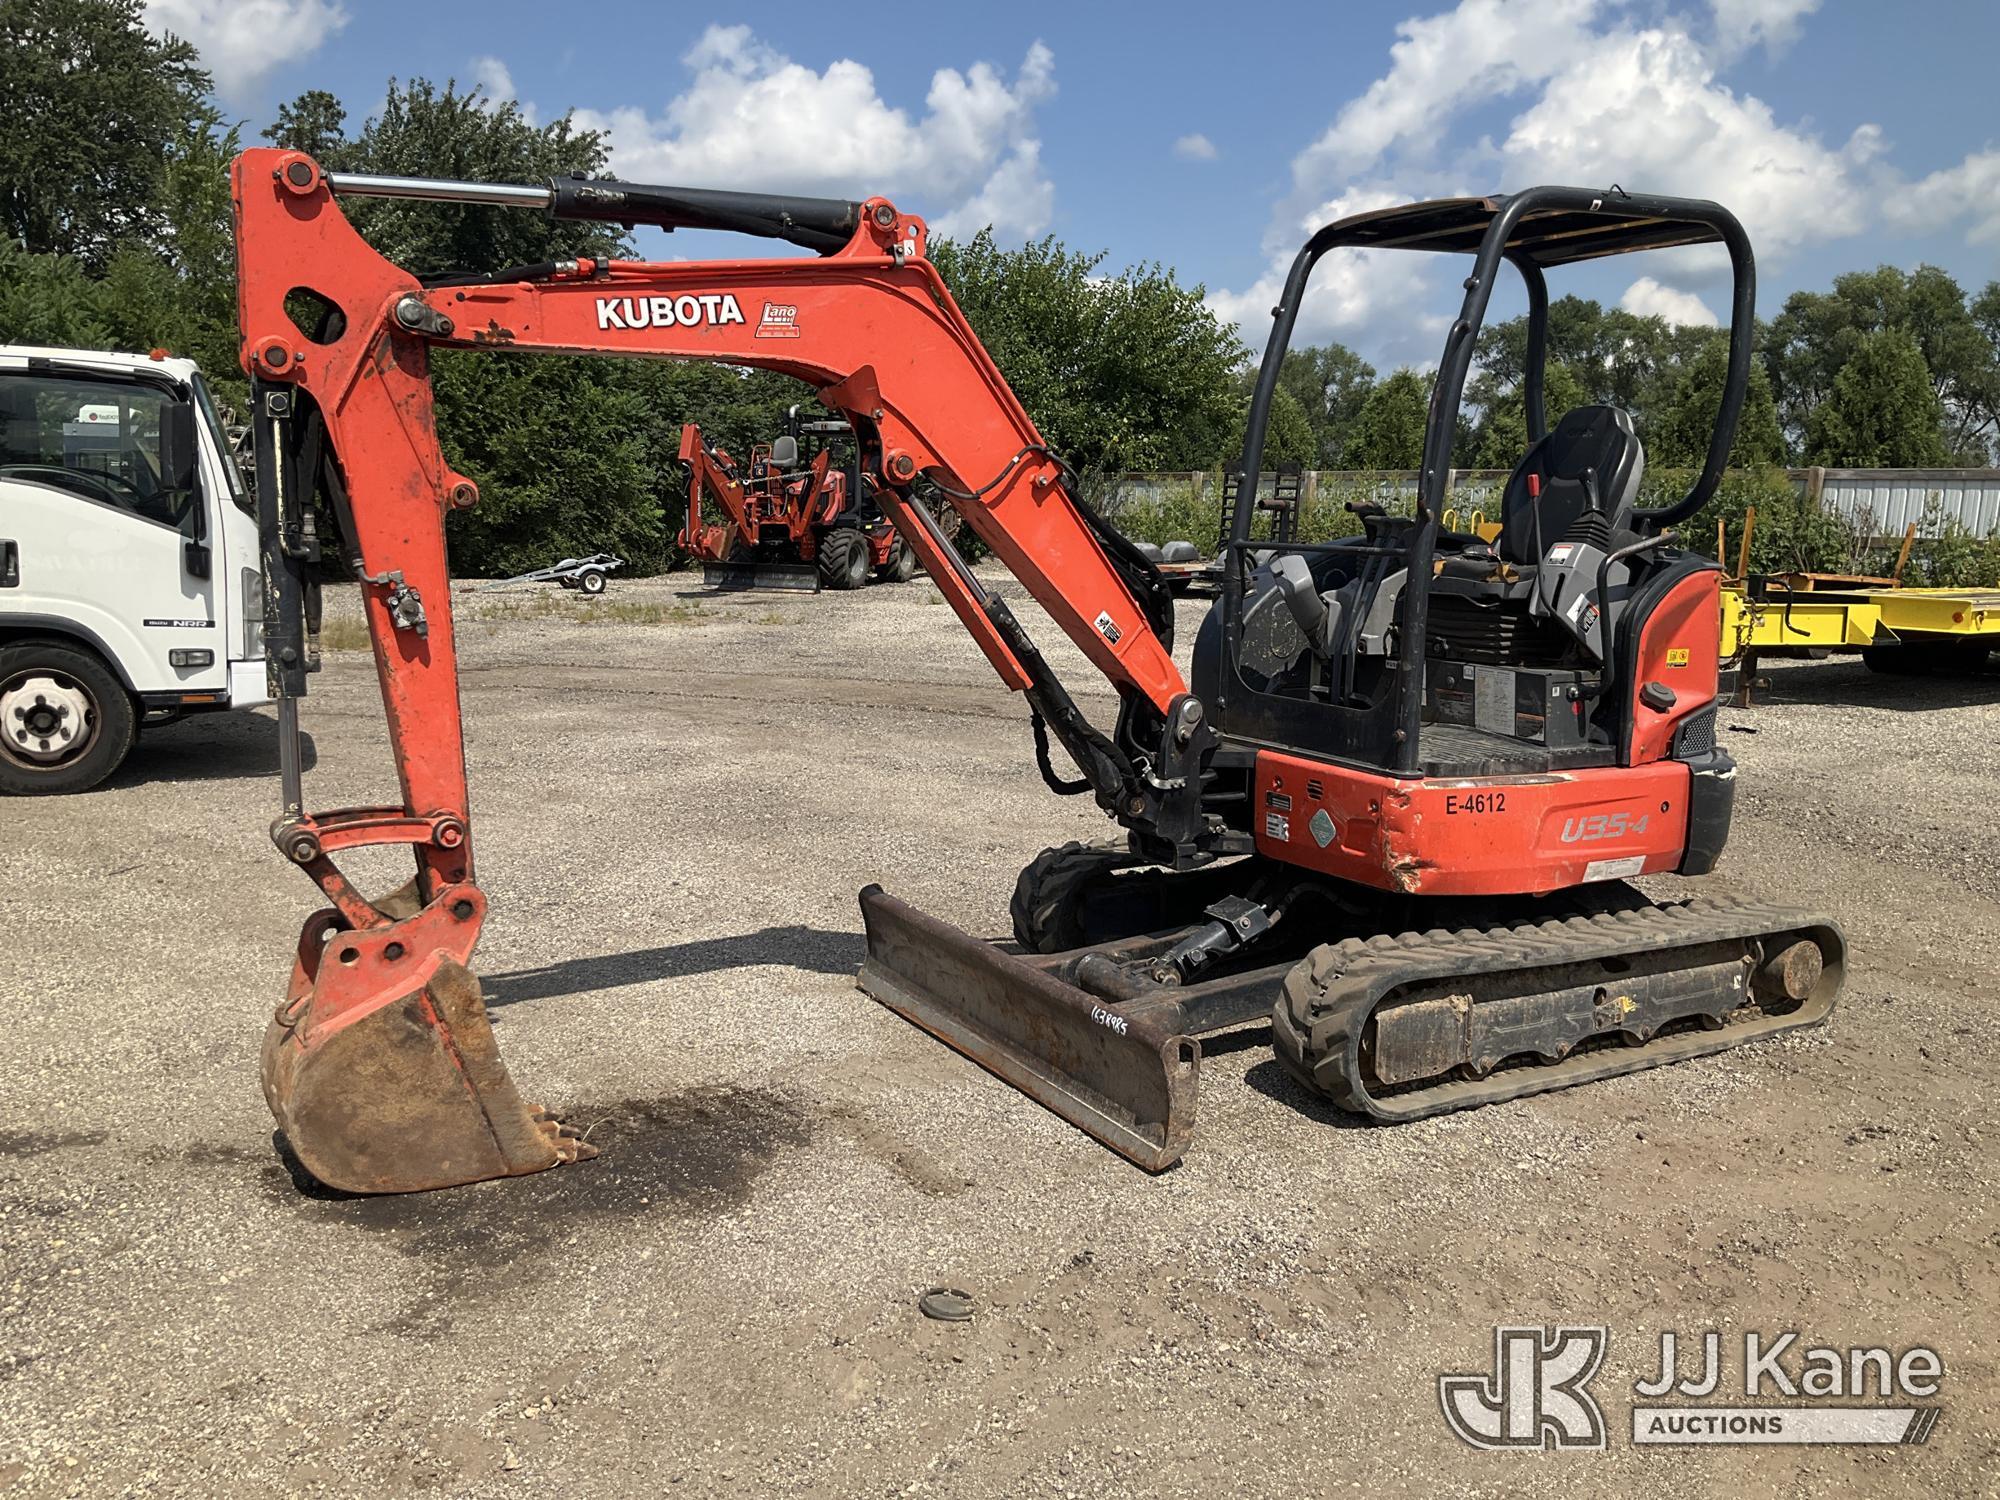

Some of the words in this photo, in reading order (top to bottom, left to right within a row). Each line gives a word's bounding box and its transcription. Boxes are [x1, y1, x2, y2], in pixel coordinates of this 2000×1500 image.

[596, 295, 745, 329] KUBOTA
[1446, 793, 1505, 815] E-4612
[1560, 813, 1648, 843] U35-4
[1091, 1005, 1128, 1036] 1638985
